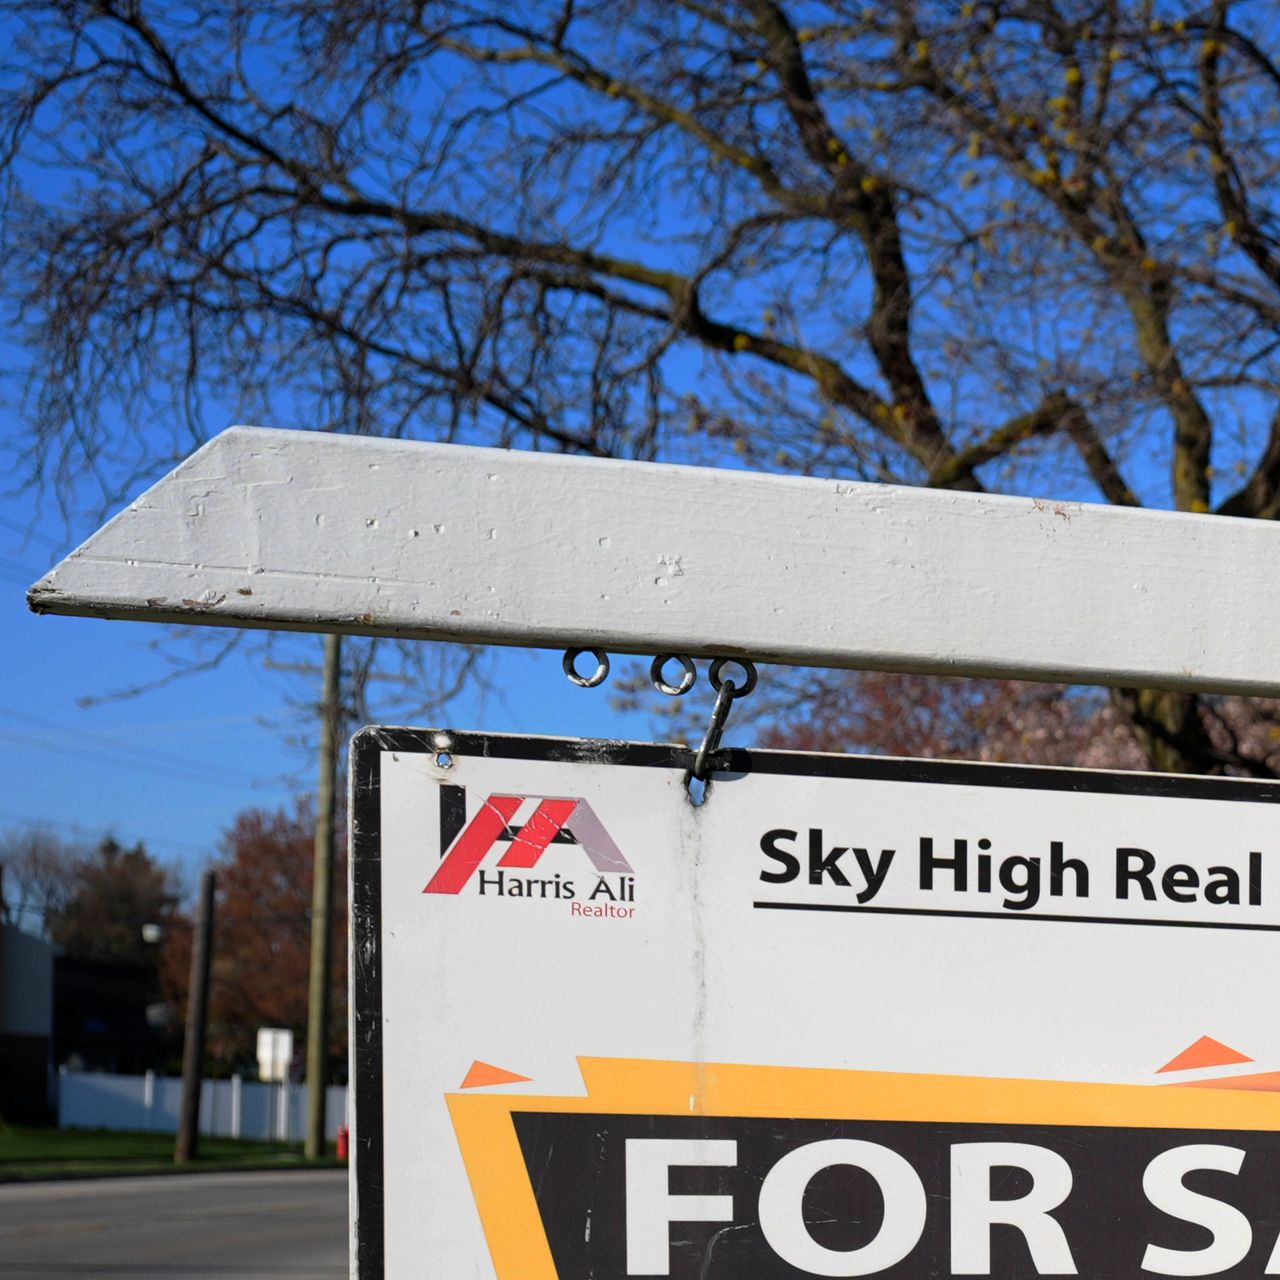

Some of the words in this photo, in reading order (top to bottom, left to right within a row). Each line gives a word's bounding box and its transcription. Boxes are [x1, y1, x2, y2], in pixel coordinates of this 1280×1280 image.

[478, 869, 576, 900] Harris
[588, 875, 635, 902] Ali
[757, 827, 896, 905] Sky
[918, 836, 1091, 911] High
[1115, 847, 1262, 907] Real
[570, 901, 636, 919] Realtor
[624, 1137, 1079, 1278] FOR
